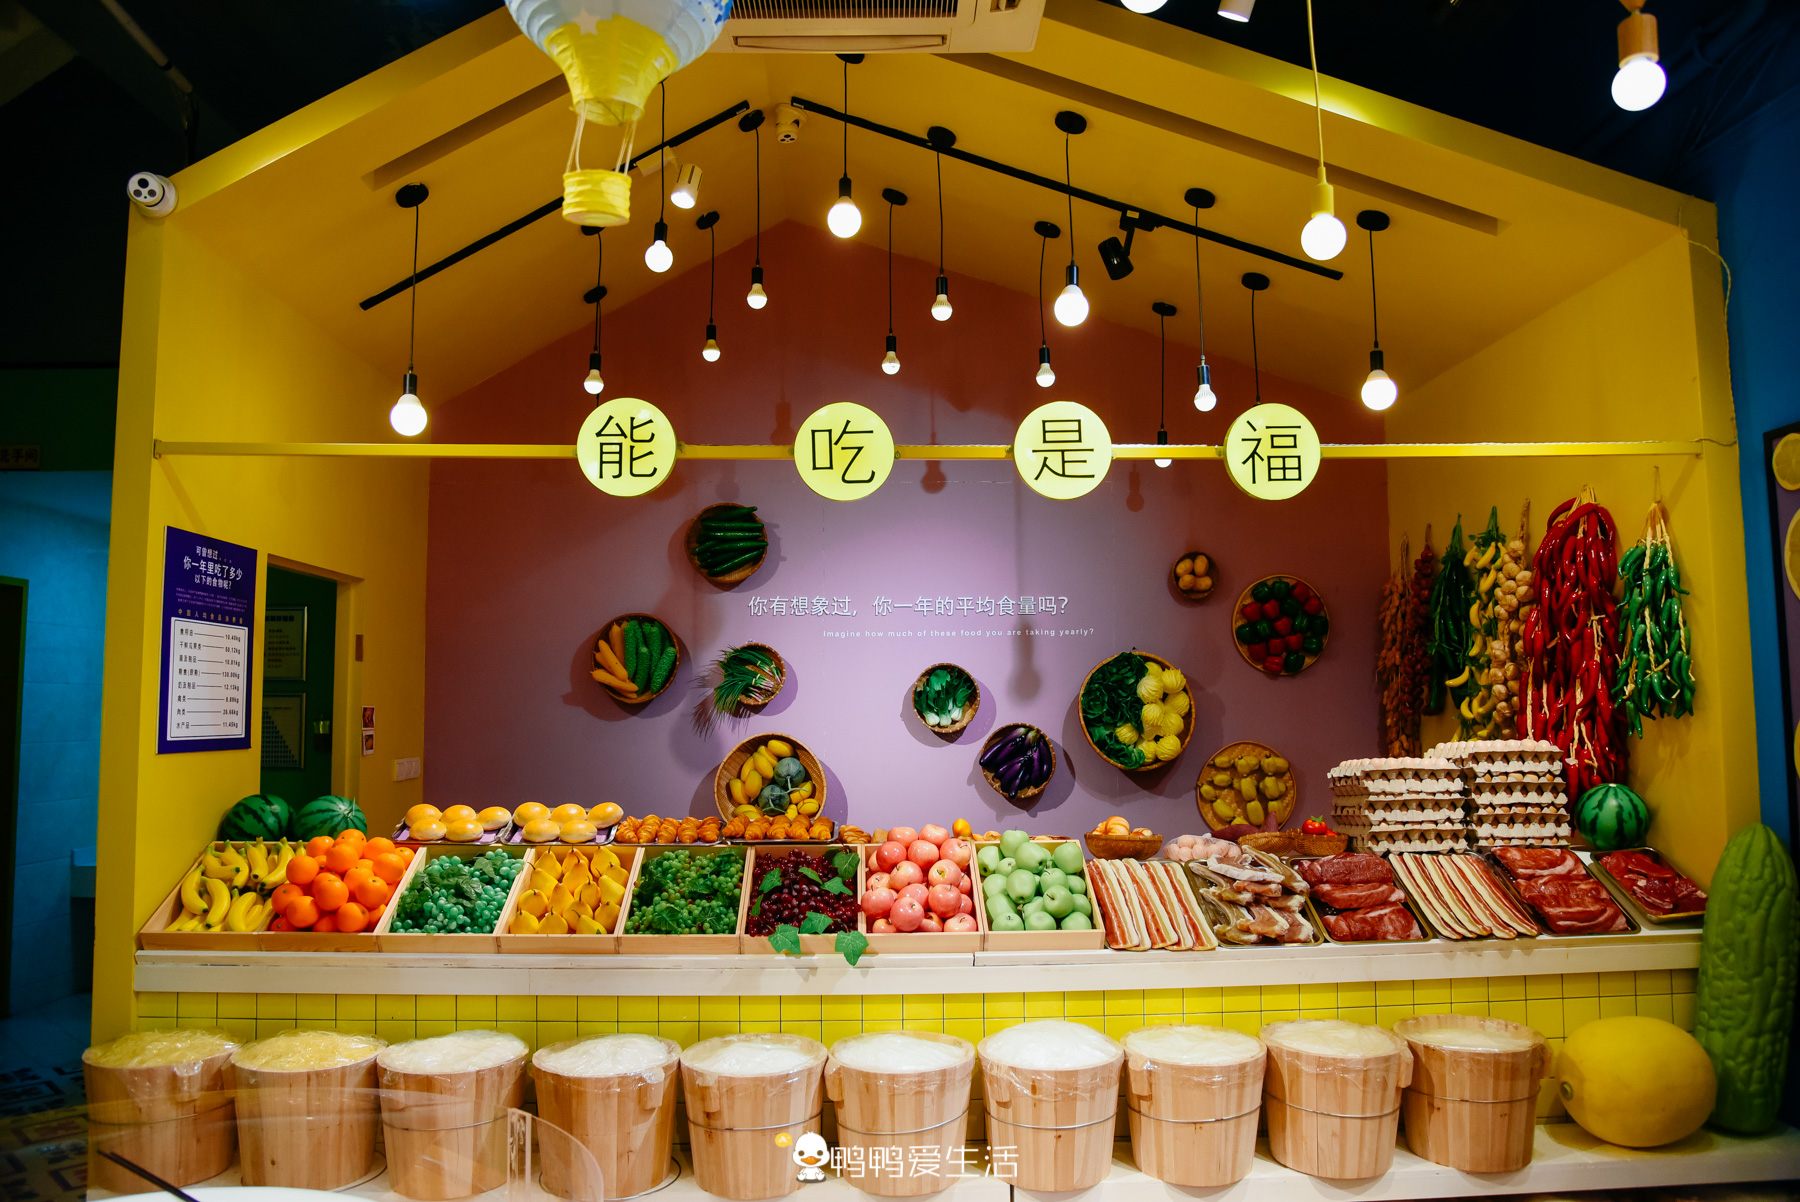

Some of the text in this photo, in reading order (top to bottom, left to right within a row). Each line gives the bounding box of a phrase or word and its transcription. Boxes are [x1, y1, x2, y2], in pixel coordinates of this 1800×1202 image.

[595, 414, 1302, 484] 能 吃 是 福
[183, 555, 243, 581] 你一年里吃了多少
[823, 630, 861, 639] Imagine
[985, 630, 1003, 638] you
[1025, 628, 1055, 637] taking
[1059, 628, 1094, 637] yearly?
[177, 708, 186, 716] 肉类
[176, 721, 190, 730] 水产品
